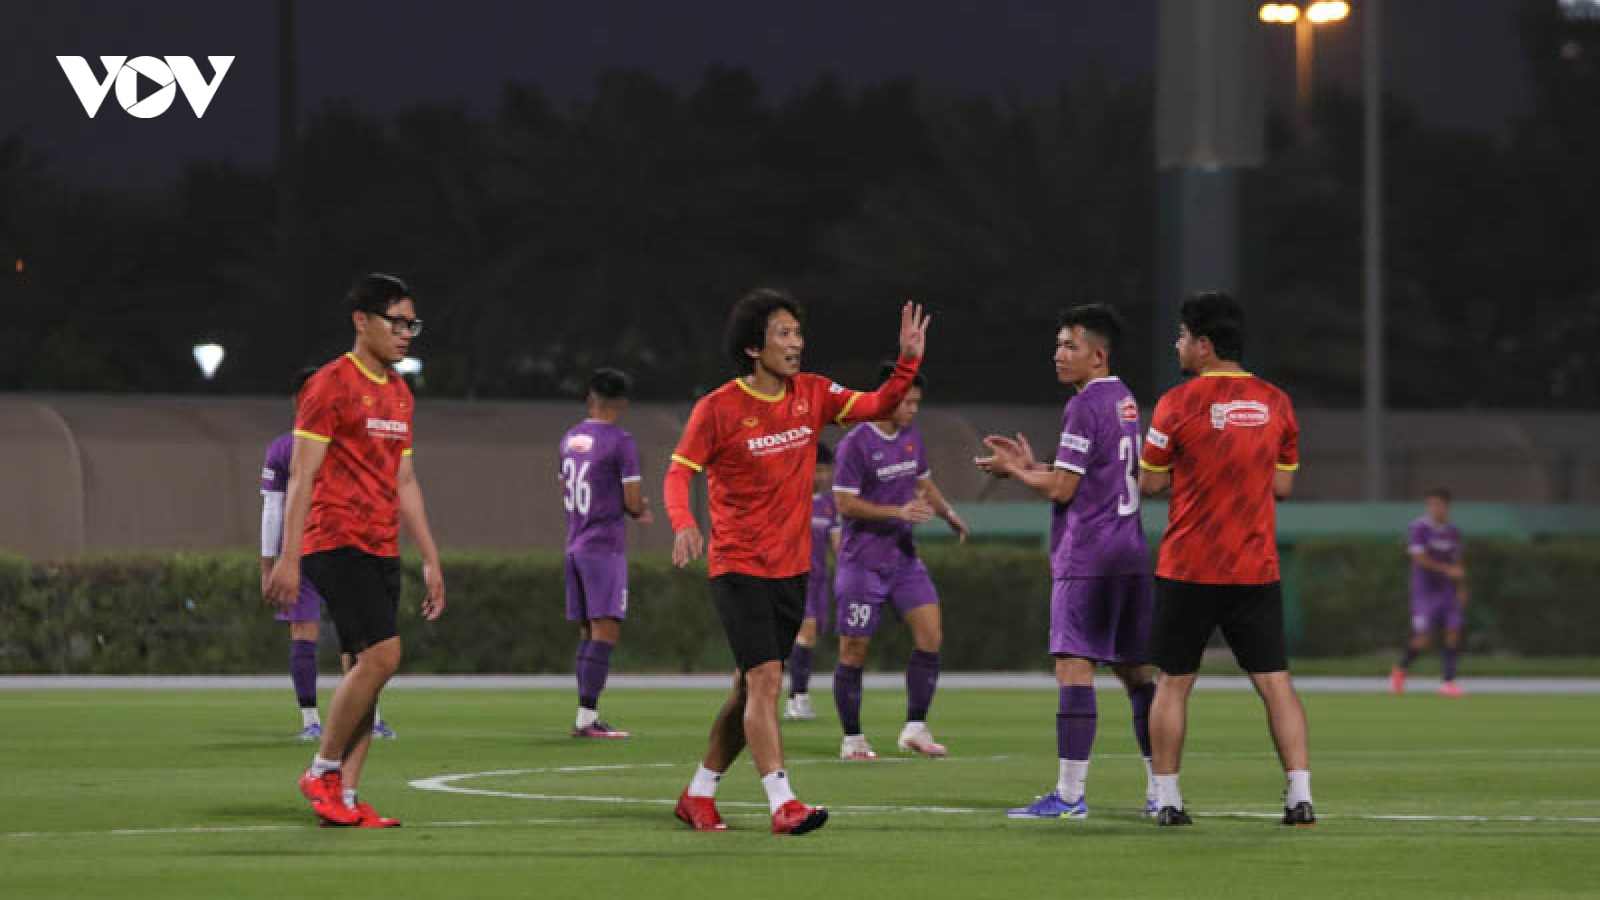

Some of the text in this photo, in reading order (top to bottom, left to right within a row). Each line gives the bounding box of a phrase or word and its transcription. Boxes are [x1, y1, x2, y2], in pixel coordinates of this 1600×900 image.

[747, 425, 812, 450] HONDA
[562, 457, 592, 515] 36
[847, 602, 872, 628] 39
